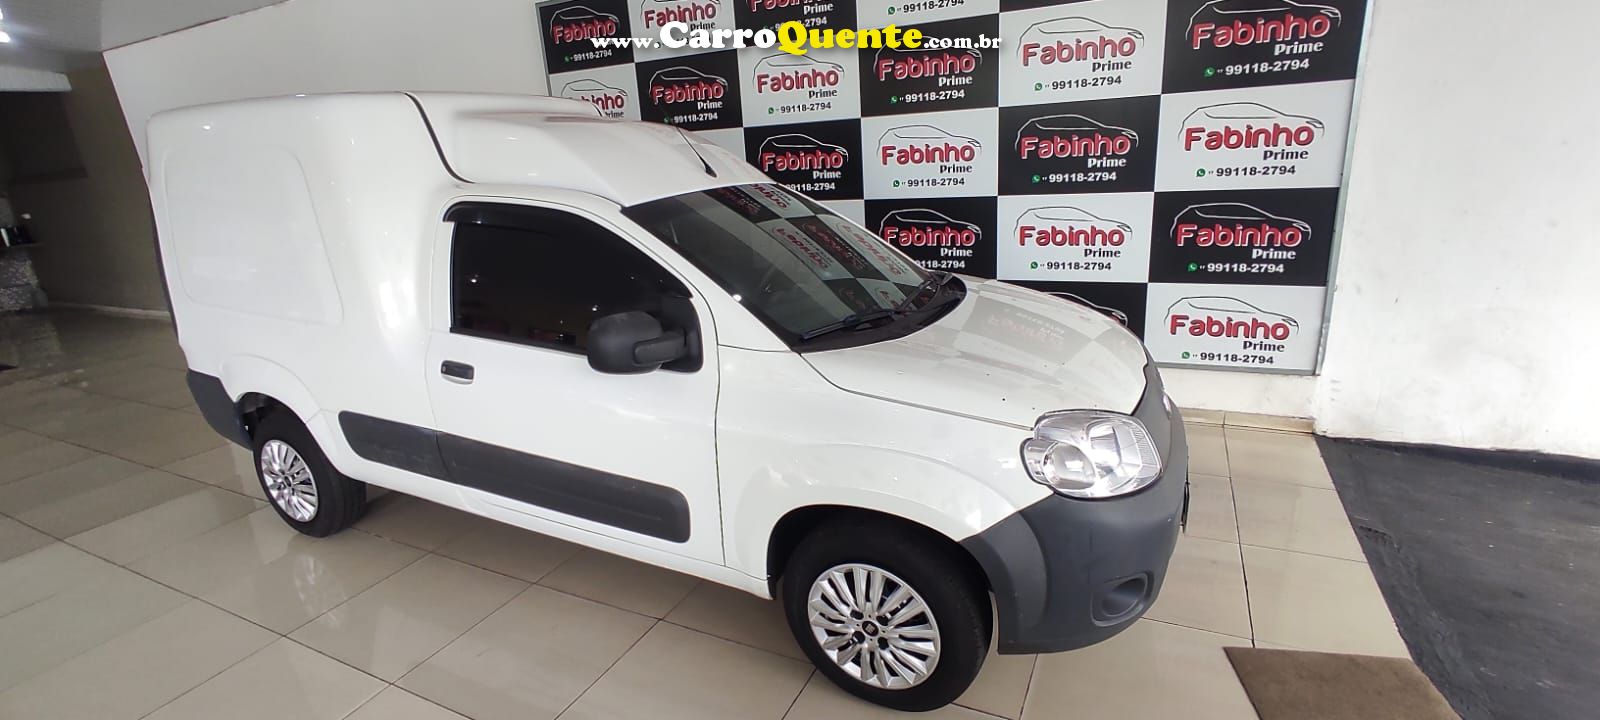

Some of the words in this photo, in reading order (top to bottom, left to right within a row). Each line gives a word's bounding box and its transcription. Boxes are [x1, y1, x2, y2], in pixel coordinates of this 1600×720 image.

[803, 3, 834, 15] Prime
[644, 3, 717, 29] Fabinho
[553, 19, 616, 44] Fabinho
[1192, 13, 1331, 50] Fabinho
[1022, 35, 1136, 66] Fabinho
[1274, 41, 1324, 56] Prime
[878, 51, 976, 81] Fabinho
[1092, 60, 1132, 72] Prime
[1225, 58, 1310, 76] 99118-2794
[757, 68, 840, 93] Fabinho
[938, 74, 973, 87] Prime
[1051, 75, 1122, 90] 99118-2794
[652, 81, 724, 105] Fabinho
[808, 88, 838, 99] Prime
[905, 90, 965, 104] 99118-2794
[697, 100, 723, 110] Prime
[780, 101, 831, 114] 99118-2794
[1184, 122, 1315, 151] Fabinho
[1020, 132, 1131, 159] Fabinho
[761, 149, 843, 172] Fabinho
[881, 143, 976, 166] Fabinho
[1263, 149, 1309, 160] Prime
[939, 164, 973, 174] Prime
[1087, 157, 1127, 168] Prime
[812, 169, 842, 179] Prime
[1049, 172, 1117, 183] 99118-2794
[1216, 165, 1296, 177] 99118-2794
[907, 177, 965, 188] 99118-2794
[883, 224, 976, 247] Fabinho
[1019, 225, 1125, 247] Fabinho
[1176, 223, 1303, 247] Fabinho
[940, 247, 973, 257] Prime
[1084, 248, 1121, 258] Prime
[1251, 248, 1297, 260] Prime
[1046, 262, 1112, 271] 99118-2794
[1207, 263, 1285, 273] 99118-2794
[1170, 314, 1290, 341] Fabinho
[1243, 340, 1285, 352] Prime
[1200, 352, 1274, 364] 99118-2794
